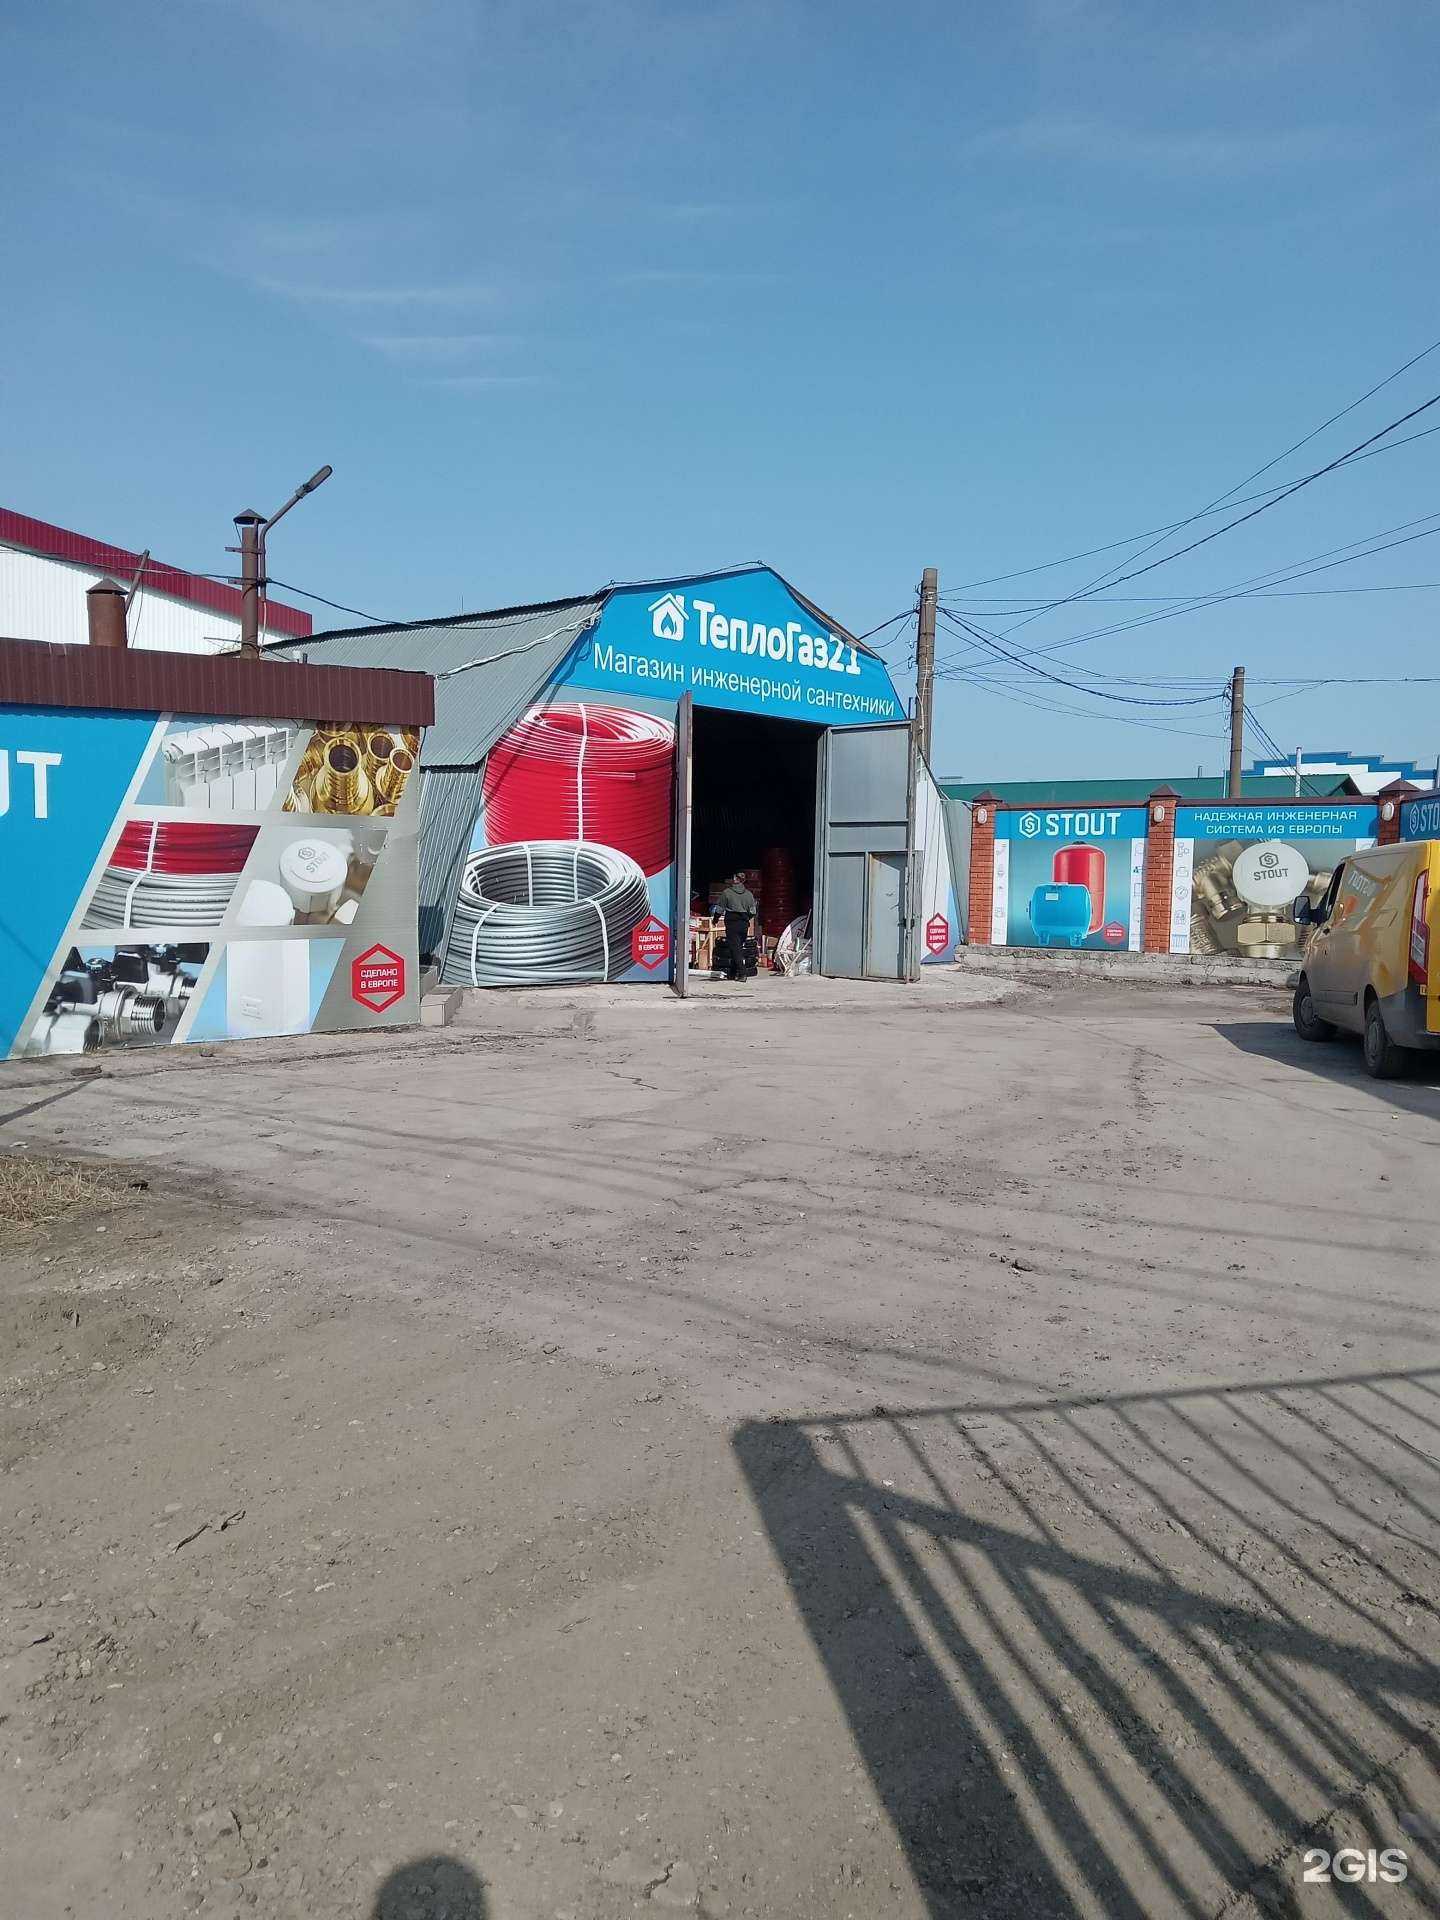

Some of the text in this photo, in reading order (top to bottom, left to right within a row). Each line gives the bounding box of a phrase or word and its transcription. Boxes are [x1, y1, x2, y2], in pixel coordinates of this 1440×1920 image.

[693, 599, 861, 675] ТеплоГаз21
[594, 643, 895, 716] Магазин инженерной сантехники
[0, 749, 63, 819] T
[1194, 811, 1357, 822] НАДЕЖНАЯ ИНЖЕНЕРНАЯ
[1045, 812, 1121, 836] STOUT
[1206, 825, 1343, 834] СИСТЕМА ИЗ ЕВРОПЫ
[1253, 868, 1289, 881] STOUT
[360, 968, 398, 979] СДЕЛАНО
[360, 979, 399, 989] В ЕВРОПЕ
